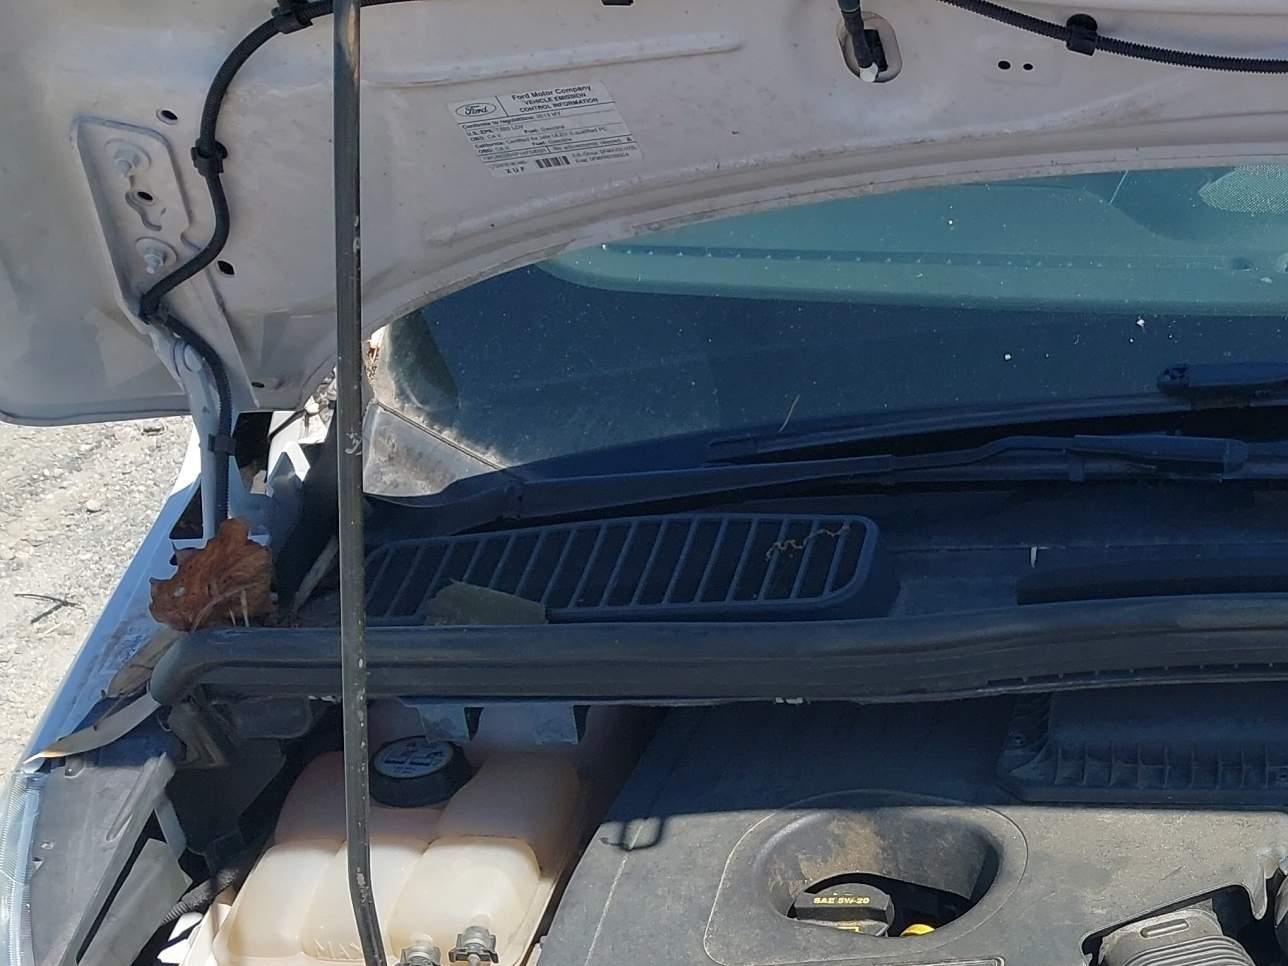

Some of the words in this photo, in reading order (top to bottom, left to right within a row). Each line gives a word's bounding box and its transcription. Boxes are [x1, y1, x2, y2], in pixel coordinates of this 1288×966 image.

[512, 92, 530, 101] Ford
[531, 89, 554, 98] Motor
[555, 84, 591, 95] Company
[525, 96, 551, 106] VEHICLE
[554, 92, 587, 101] EMISSION
[464, 104, 488, 115] Ford
[519, 102, 552, 113] CONTROL
[553, 97, 598, 108] INFORMATION
